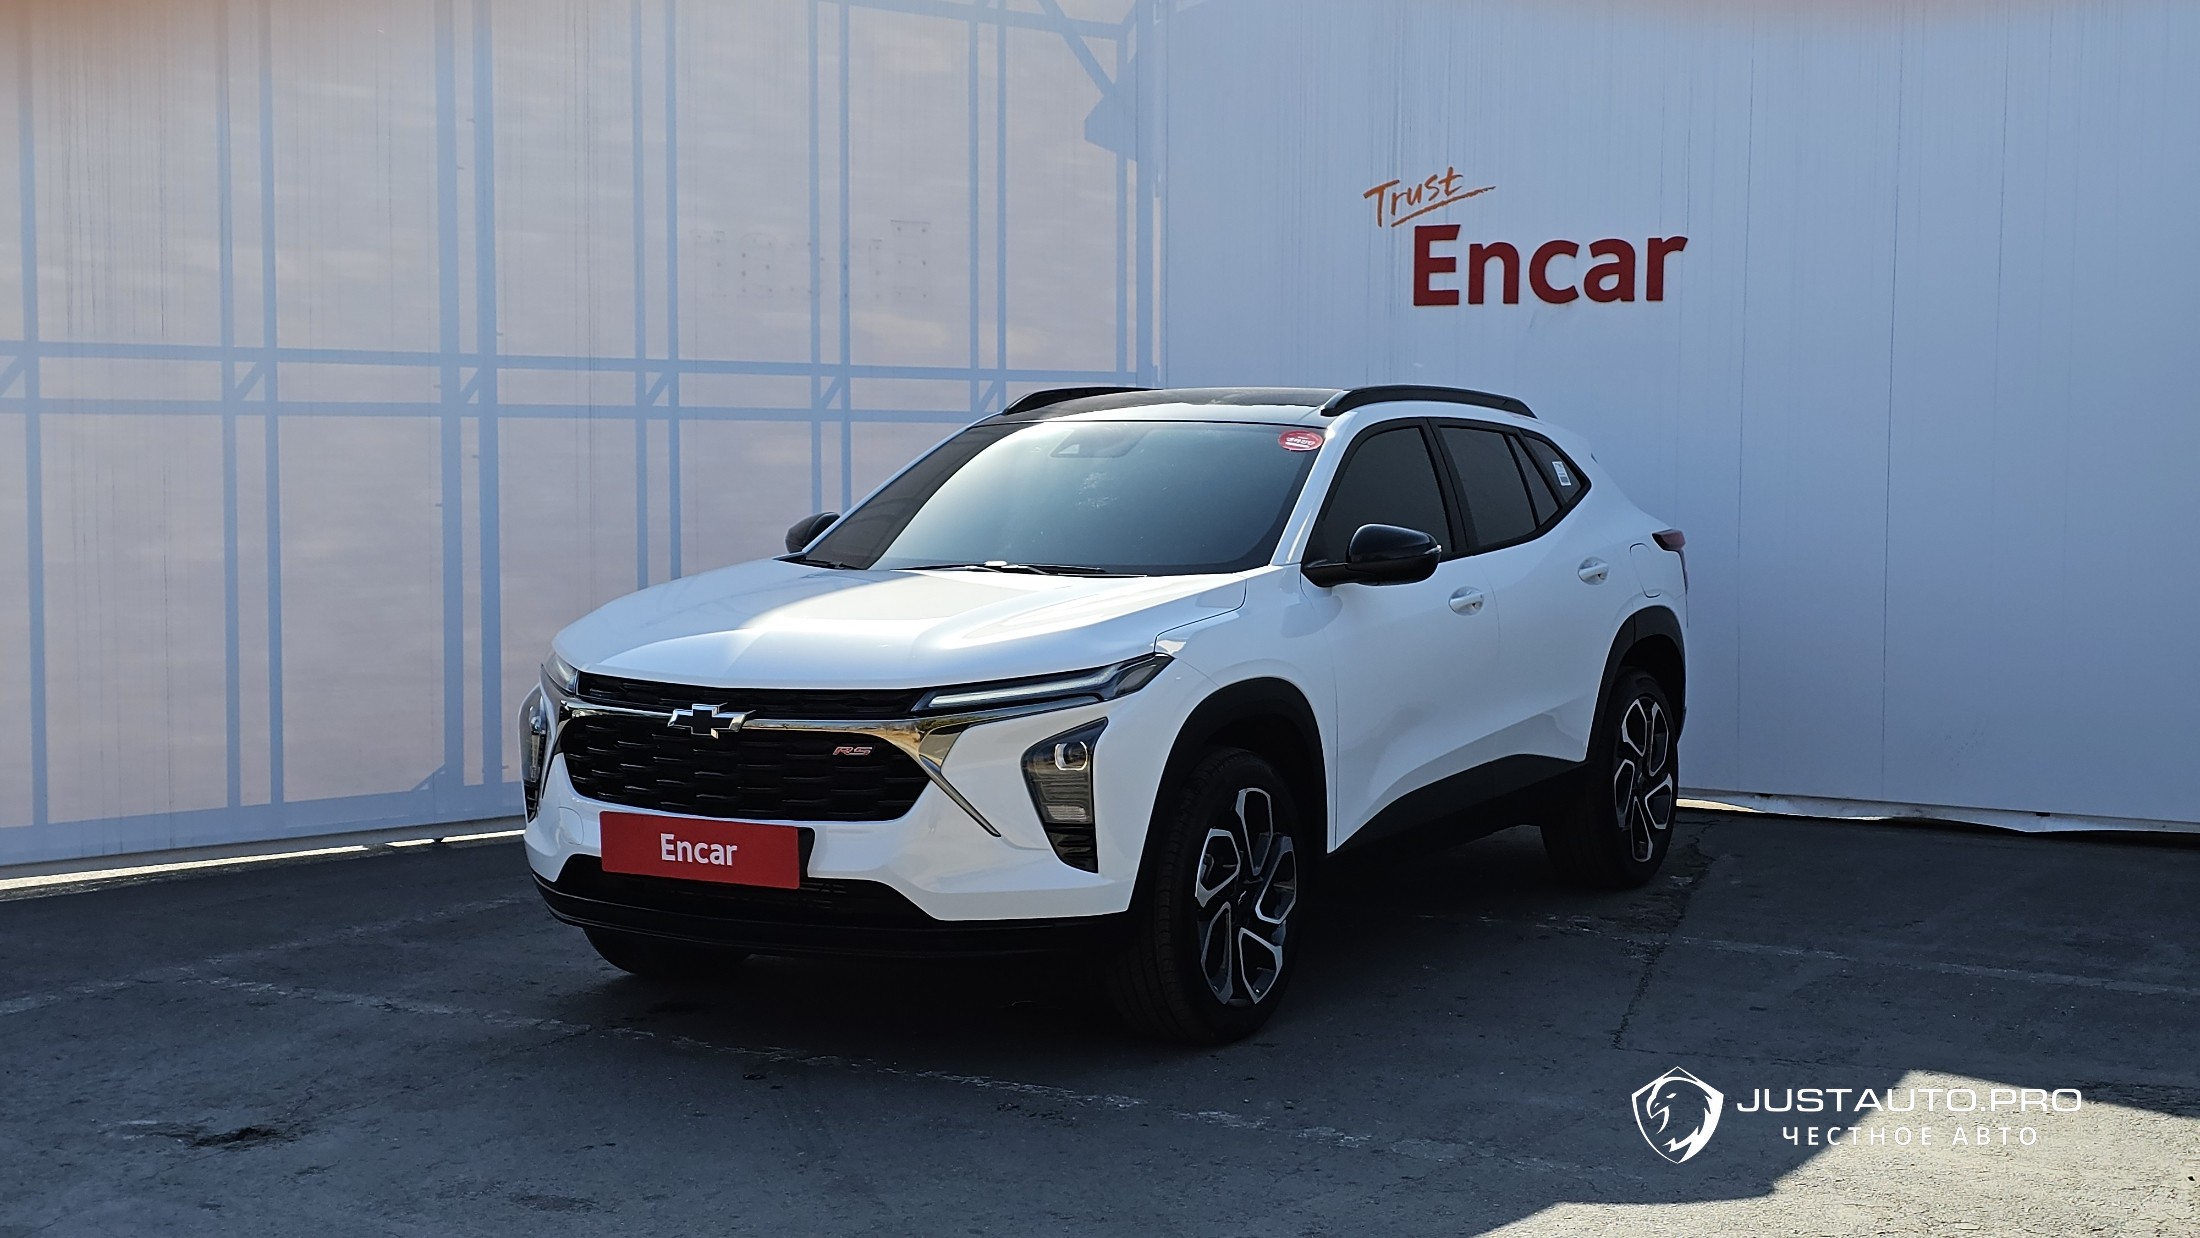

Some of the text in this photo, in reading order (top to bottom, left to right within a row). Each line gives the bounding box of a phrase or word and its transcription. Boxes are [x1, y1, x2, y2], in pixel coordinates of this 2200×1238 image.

[1363, 166, 1464, 228] Trust
[1413, 224, 1689, 306] Encar
[832, 746, 873, 756] RS
[660, 833, 738, 866] Encar
